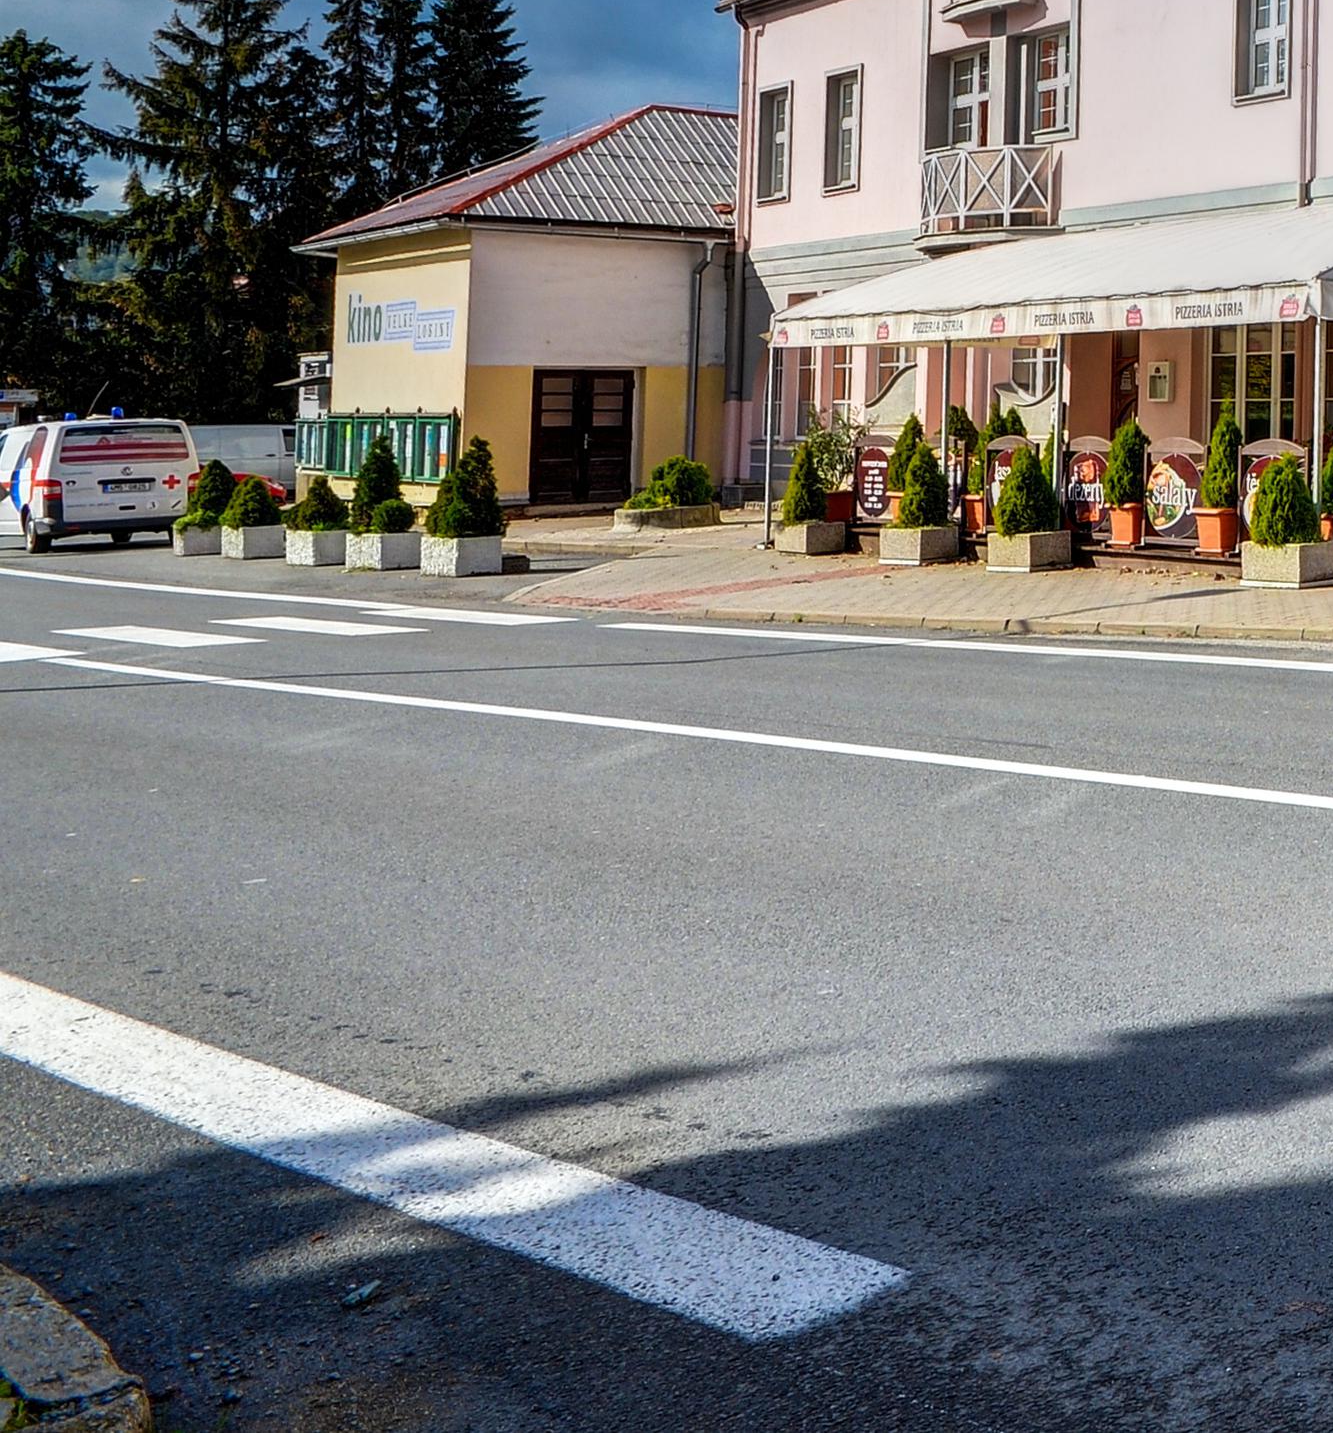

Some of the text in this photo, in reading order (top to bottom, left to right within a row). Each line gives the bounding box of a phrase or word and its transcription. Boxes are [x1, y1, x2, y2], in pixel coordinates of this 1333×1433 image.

[347, 294, 382, 343] kino
[1033, 311, 1095, 327] PIZZERIA ISTRIA
[1174, 301, 1244, 321] PIZZERIA ISTRIA
[810, 327, 855, 340] PIZZERIA ISTRIA
[912, 319, 964, 335] PIZZERIA ISTRIA
